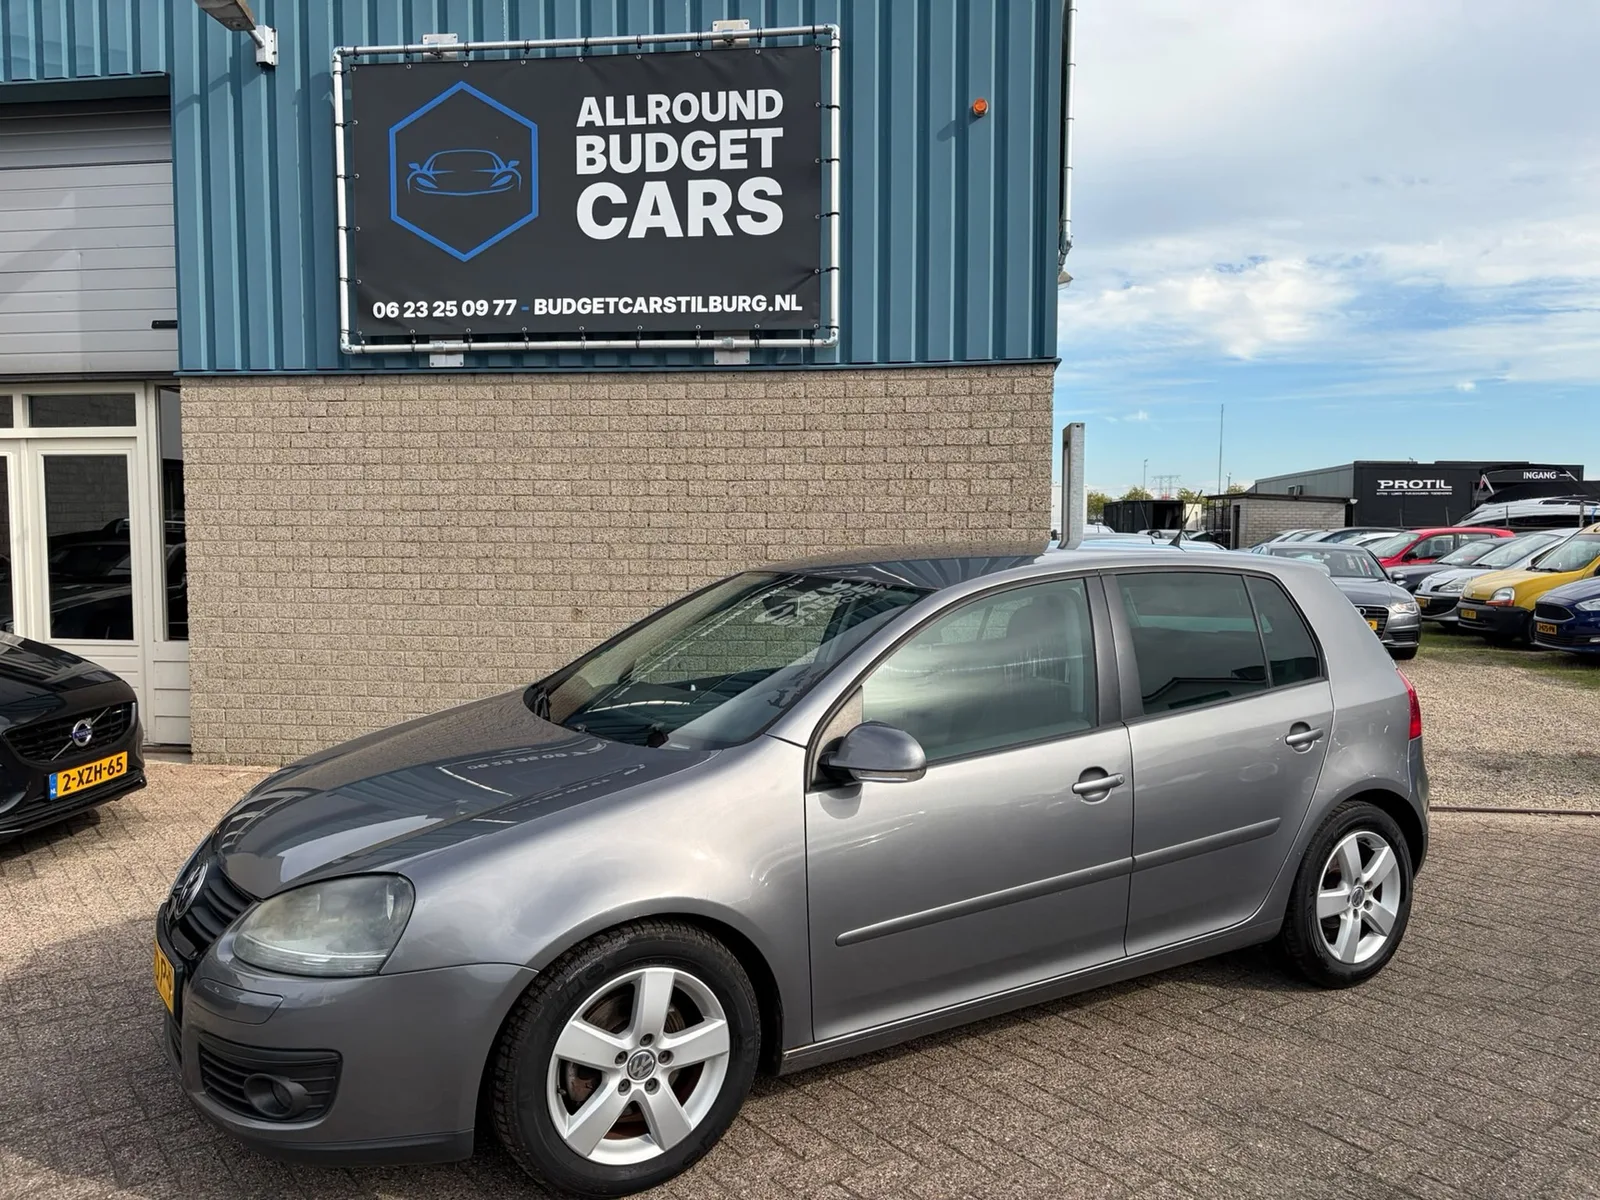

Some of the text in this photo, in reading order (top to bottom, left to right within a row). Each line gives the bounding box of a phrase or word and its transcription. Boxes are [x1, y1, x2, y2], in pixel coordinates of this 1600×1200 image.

[576, 88, 784, 128] ALLROUND
[576, 127, 784, 175] BUDGET
[576, 176, 784, 240] CARS
[372, 301, 400, 319] 06
[403, 300, 429, 318] 23
[432, 300, 458, 318] 25
[461, 299, 489, 317] 09
[492, 298, 518, 316] 77
[533, 293, 803, 316] BUDGETCARSTILBURG.NL
[1376, 479, 1453, 489] PROTIL
[1523, 471, 1557, 480] INGANG
[62, 756, 123, 792] 2-XZH-65
